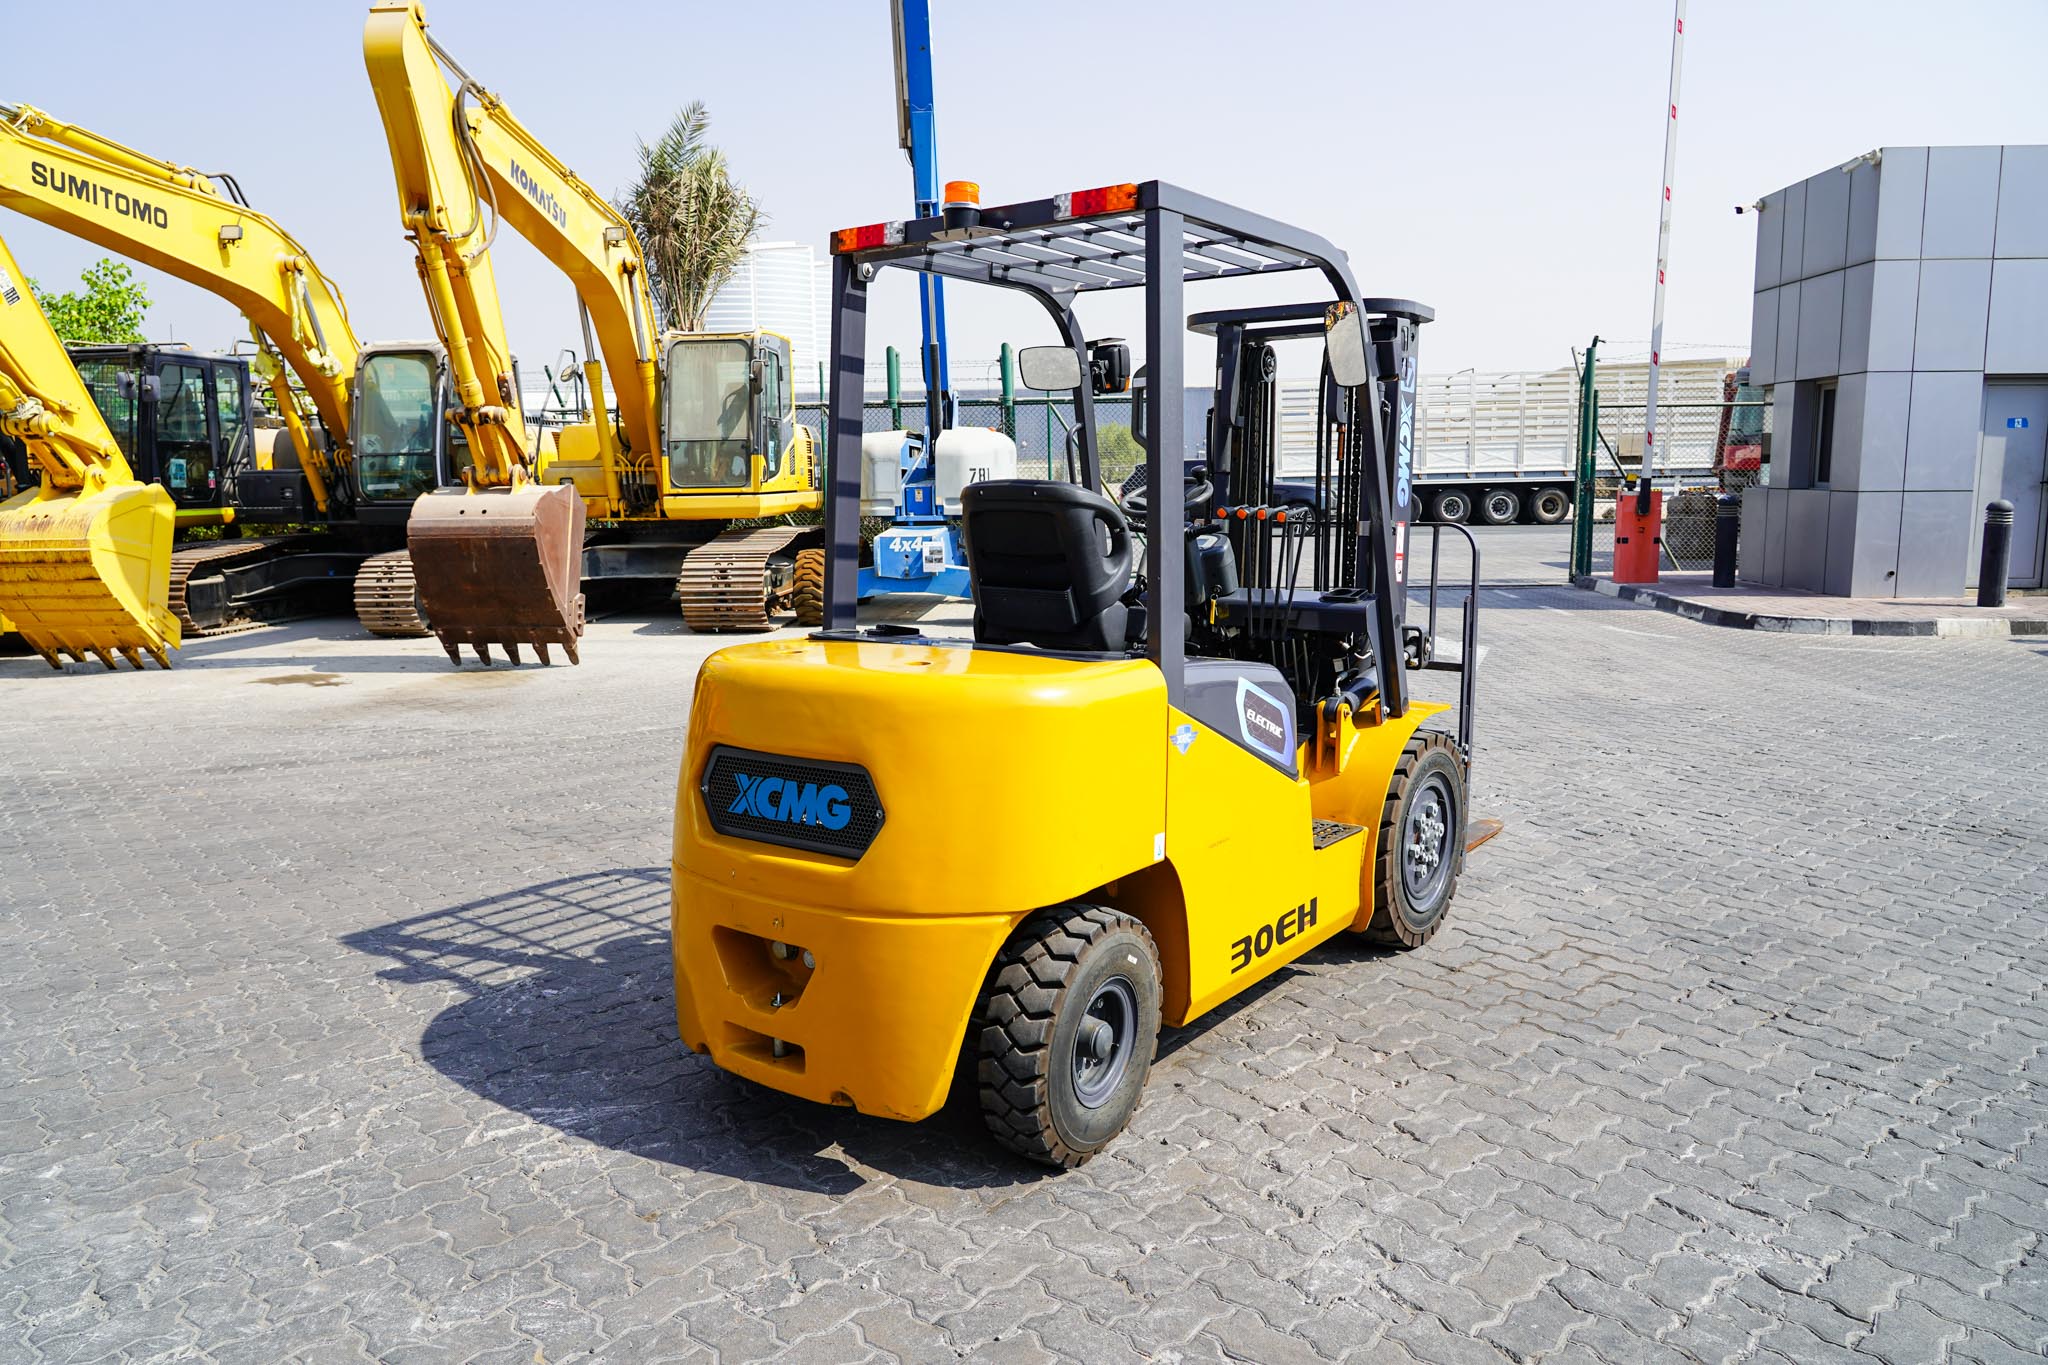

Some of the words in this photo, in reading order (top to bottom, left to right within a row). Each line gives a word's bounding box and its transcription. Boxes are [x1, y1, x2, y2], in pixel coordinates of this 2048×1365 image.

[31, 161, 168, 230] SUMITOMO
[511, 159, 567, 229] KOMATSU
[1397, 394, 1413, 508] XCMG
[889, 536, 924, 553] 4x4
[1246, 709, 1284, 739] ELECTRIC
[728, 773, 852, 831] XCMG
[1231, 896, 1318, 975] 30EH
